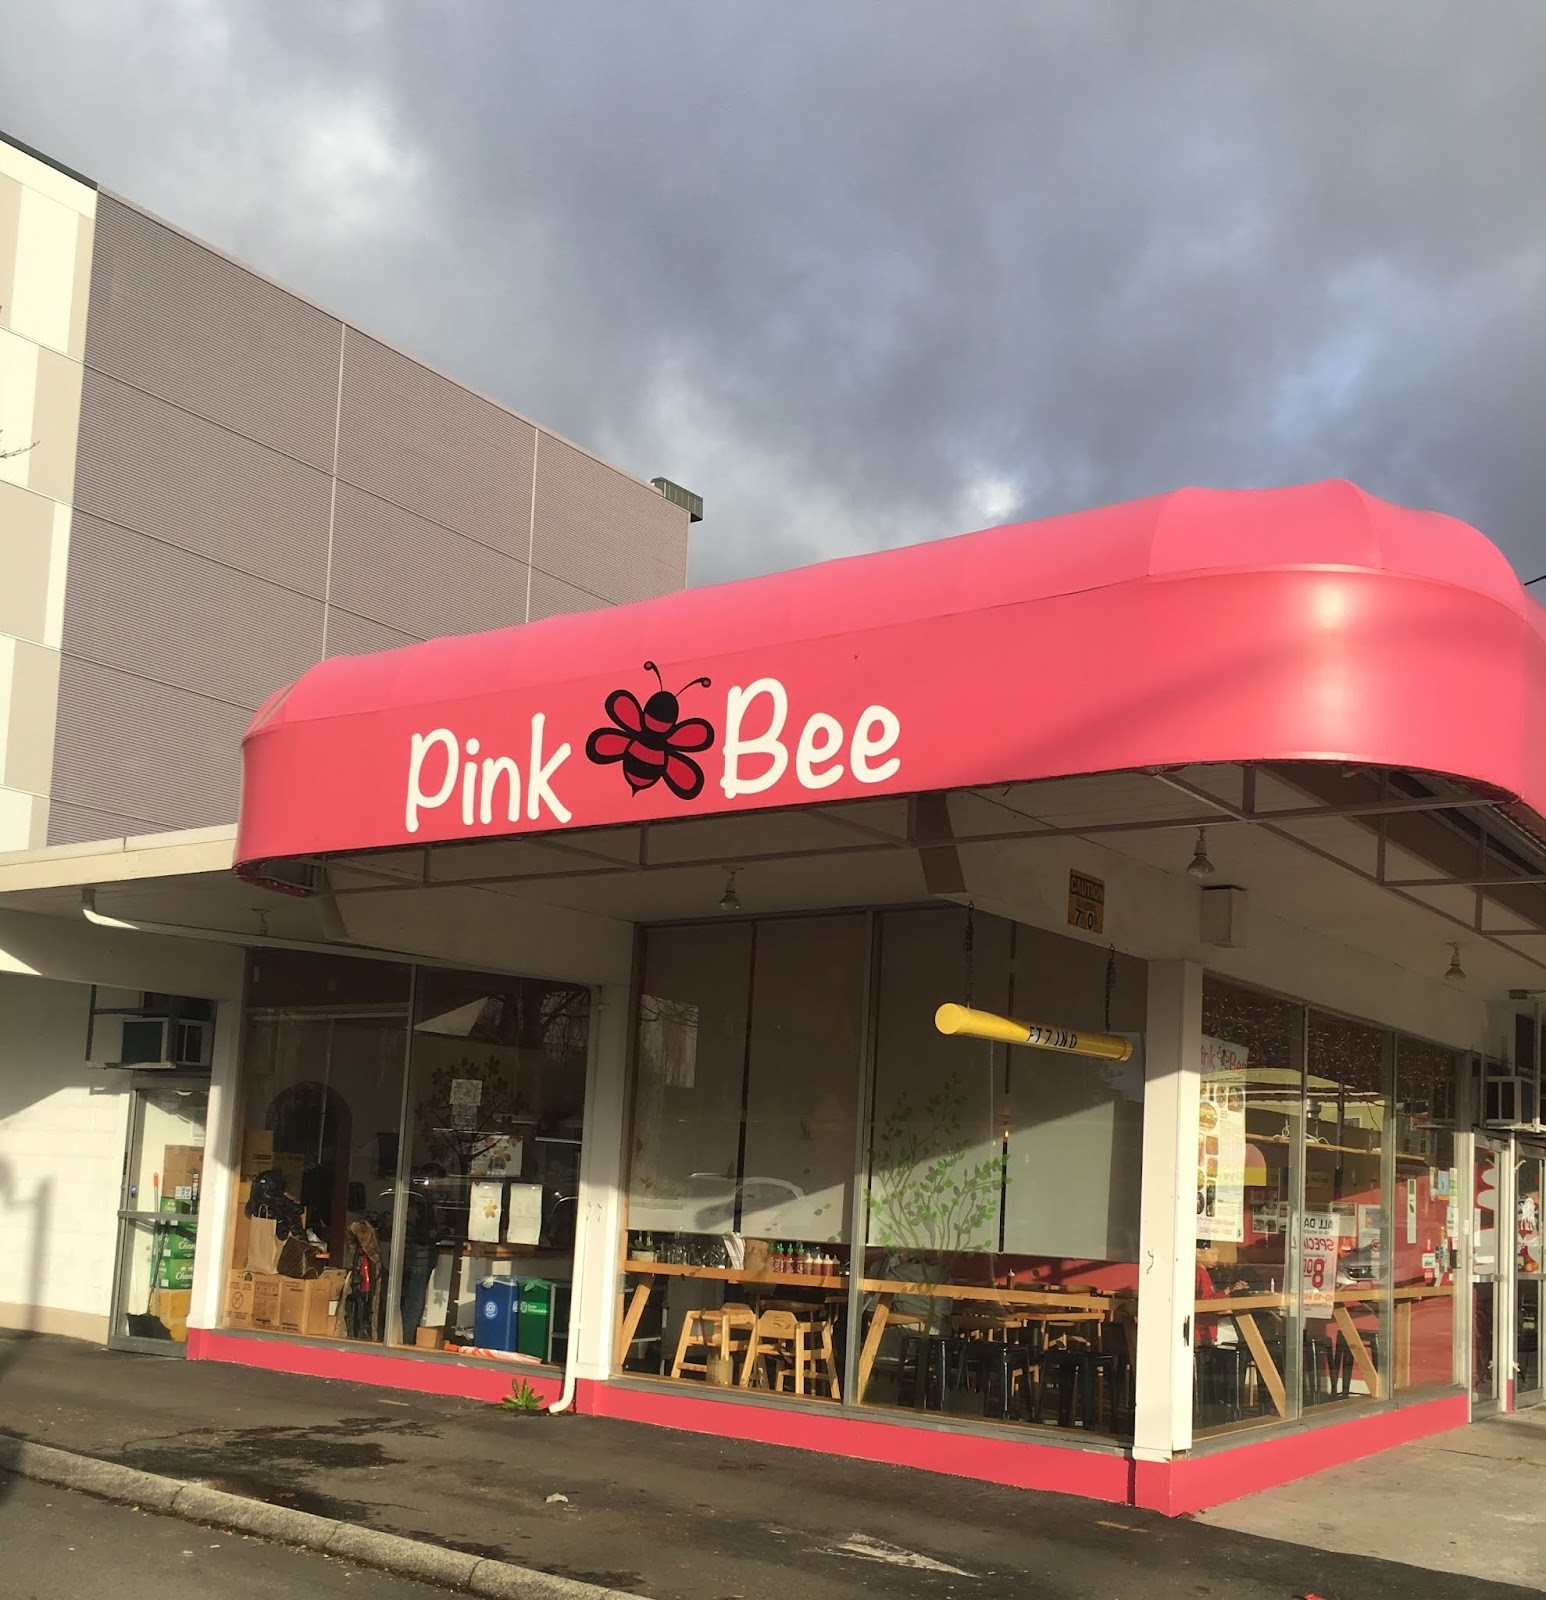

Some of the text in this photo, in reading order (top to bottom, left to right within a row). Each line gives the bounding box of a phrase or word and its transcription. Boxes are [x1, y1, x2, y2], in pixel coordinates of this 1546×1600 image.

[405, 677, 901, 833] Pink Bee
[1071, 877, 1104, 902] CAUTION
[1200, 1045, 1215, 1069] ink
[178, 1242, 196, 1250] Chan
[175, 1272, 193, 1280] Chan
